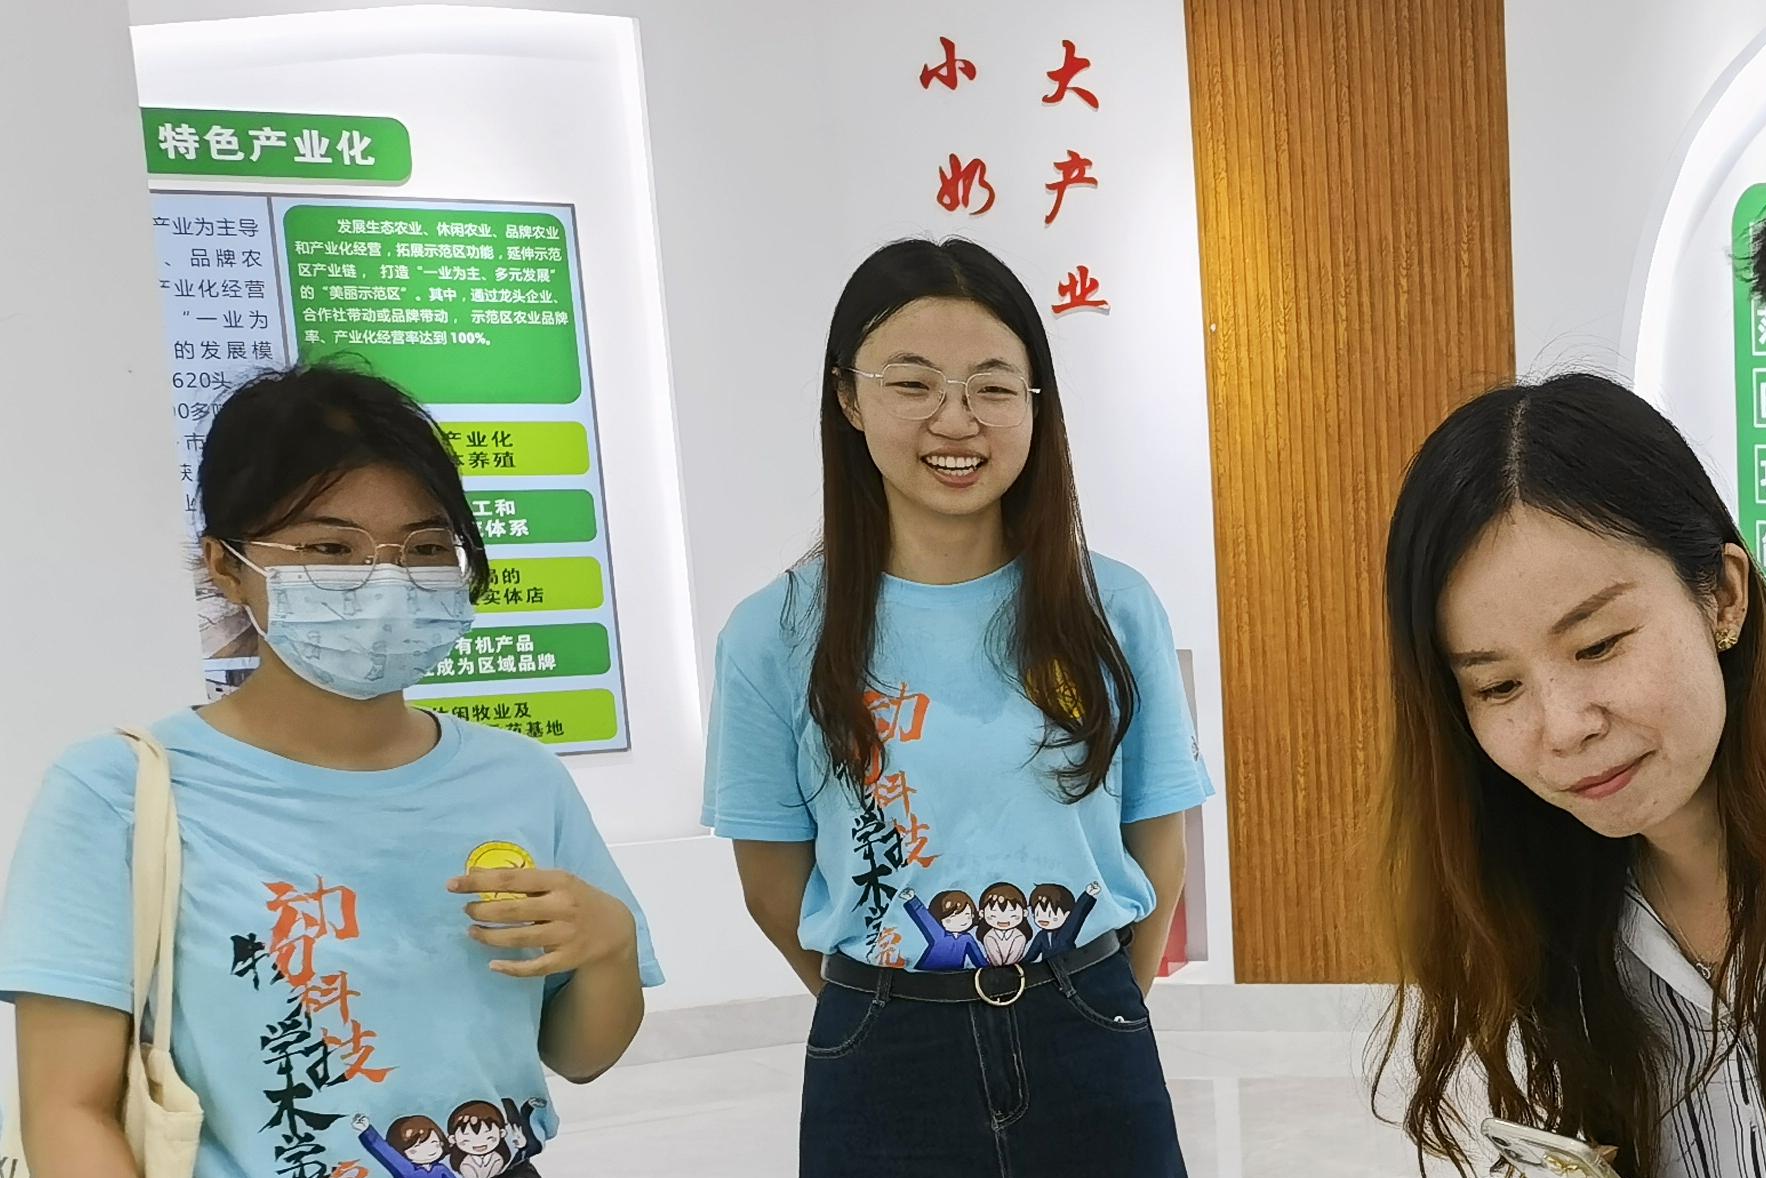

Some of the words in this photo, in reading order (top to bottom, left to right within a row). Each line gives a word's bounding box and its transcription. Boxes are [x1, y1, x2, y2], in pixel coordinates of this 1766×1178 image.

[158, 122, 376, 166] 特色产业化
[174, 340, 273, 361] 的发展模
[455, 633, 535, 656] 有机产品
[424, 652, 558, 677] 成为区域品牌
